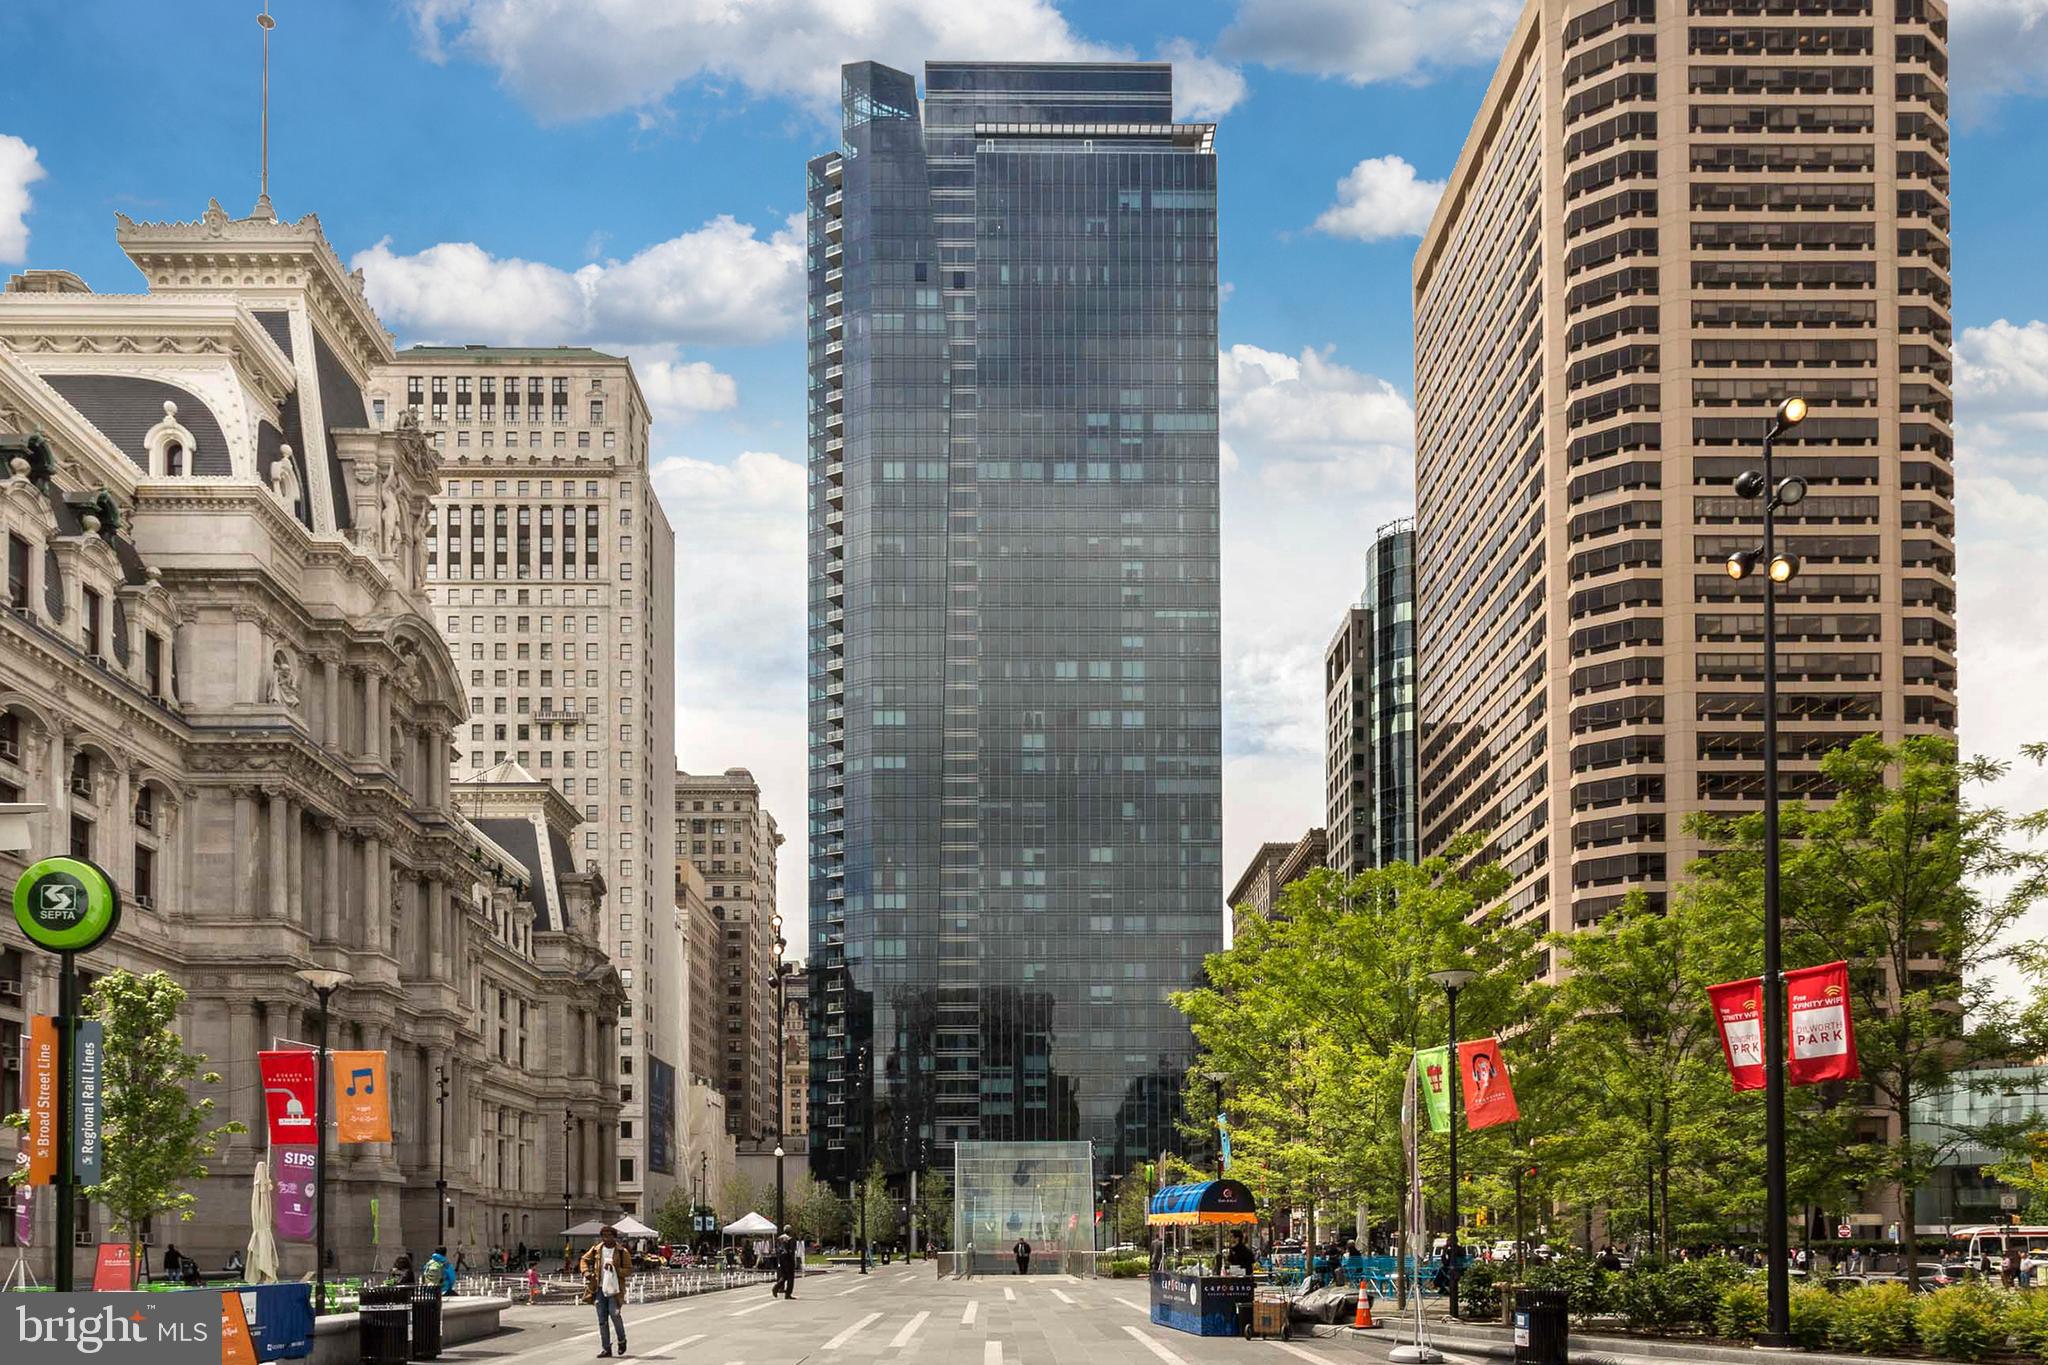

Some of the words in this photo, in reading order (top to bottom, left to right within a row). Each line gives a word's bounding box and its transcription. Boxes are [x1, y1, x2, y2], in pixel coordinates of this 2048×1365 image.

[40, 910, 76, 920] SEPTA
[1793, 1000, 1823, 1010] XFINITY
[1796, 1021, 1843, 1034] DILWORTH
[1797, 1030, 1843, 1046] PARK
[37, 1043, 51, 1069] Line
[81, 1041, 95, 1072] Lines
[1732, 1042, 1760, 1055] PARK
[37, 1072, 51, 1109] Street
[81, 1076, 95, 1099] Rail
[37, 1112, 51, 1146] Broad
[81, 1102, 97, 1154] Regional
[284, 1152, 316, 1167] SIPS
